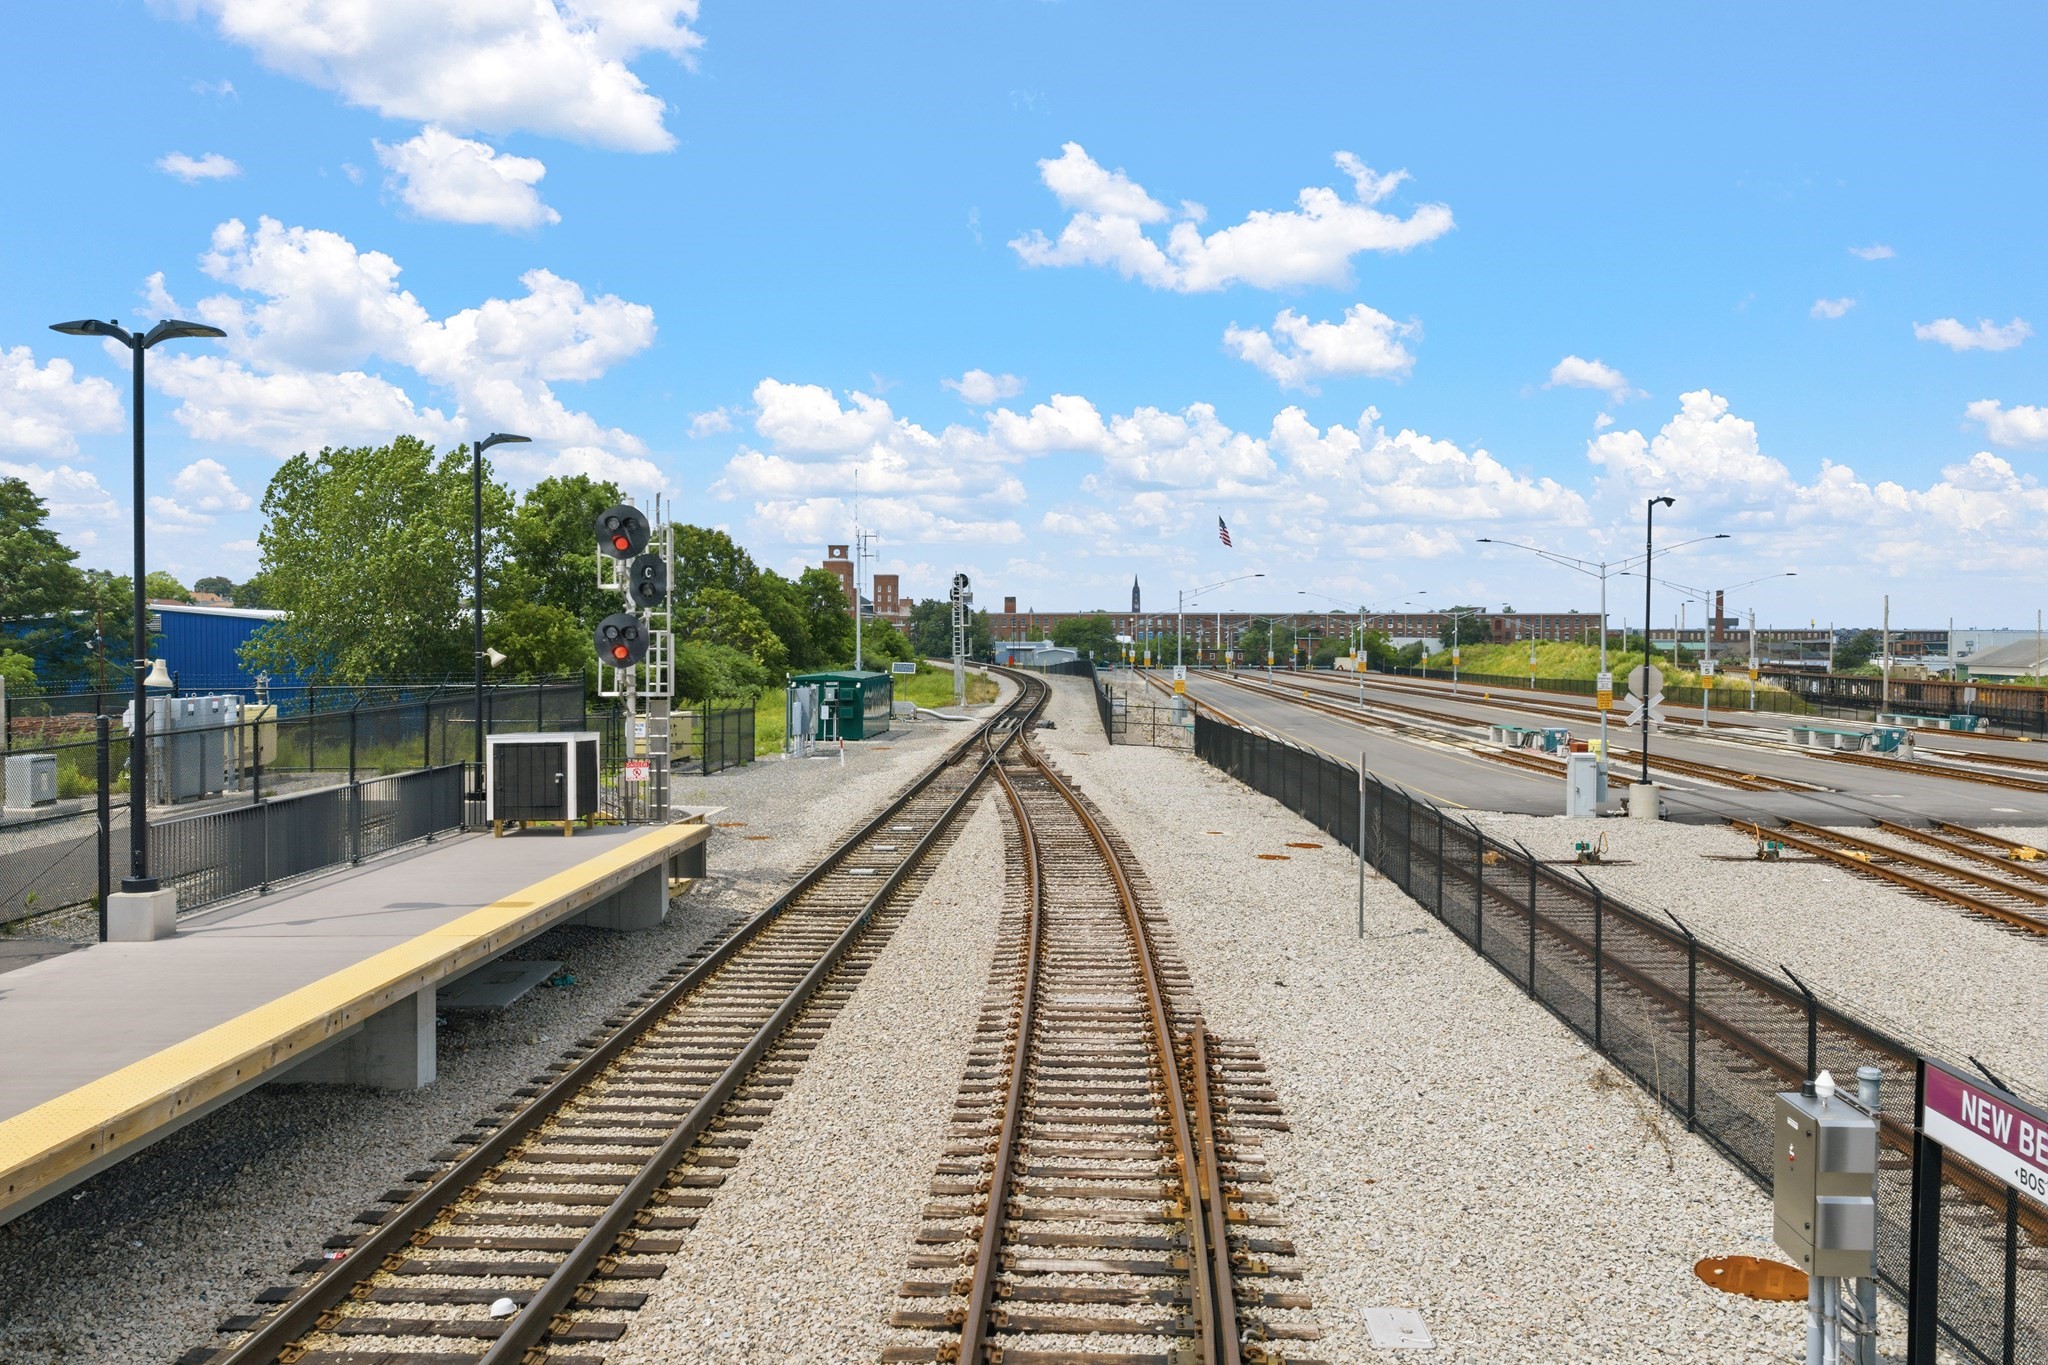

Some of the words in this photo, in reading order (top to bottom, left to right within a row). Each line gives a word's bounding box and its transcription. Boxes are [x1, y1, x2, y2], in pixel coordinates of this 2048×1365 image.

[645, 567, 653, 578] C
[1961, 1089, 2013, 1145] NEW
[2020, 1167, 2048, 1196] BOS
